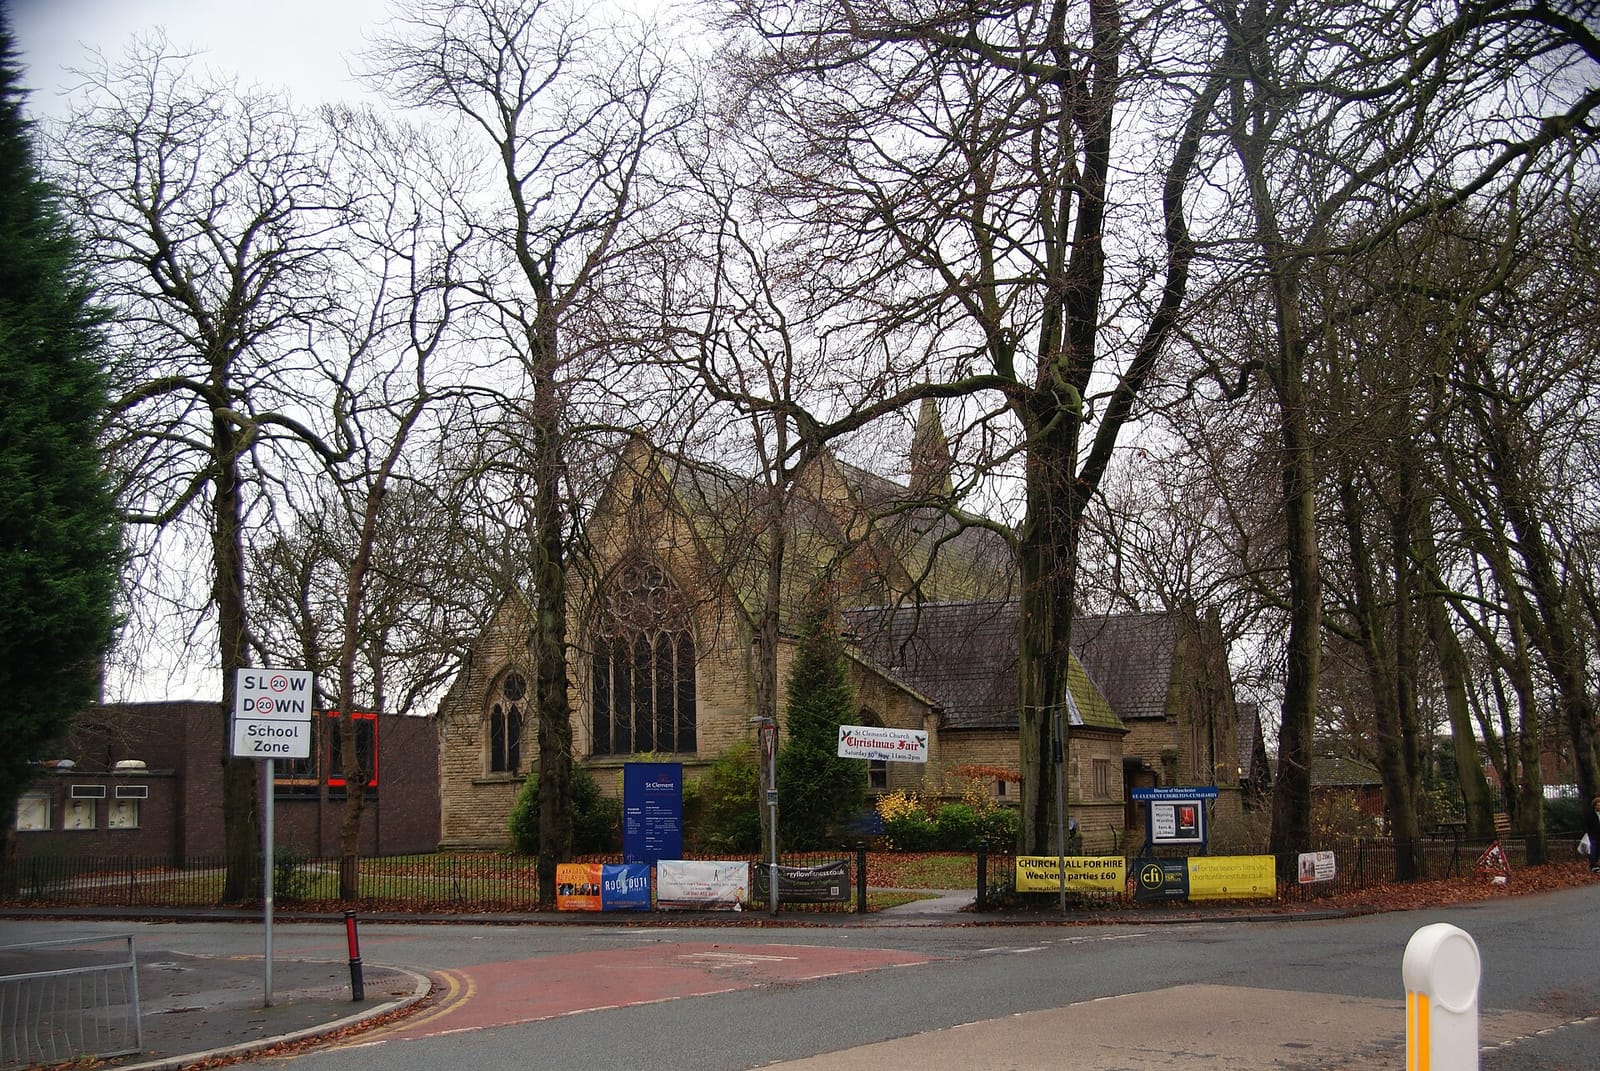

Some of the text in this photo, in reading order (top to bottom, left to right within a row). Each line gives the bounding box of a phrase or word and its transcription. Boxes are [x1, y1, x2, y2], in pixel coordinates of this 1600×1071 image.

[247, 725, 299, 738] School
[862, 730, 888, 738] Clement's
[889, 732, 910, 740] Church
[254, 740, 290, 753] Zone
[846, 736, 920, 751] Christmas Fair
[845, 749, 867, 757] Saturday
[1018, 859, 1056, 868] CHURCH
[1083, 860, 1101, 868] FOR
[1103, 859, 1123, 868] HIRE
[1068, 872, 1098, 881] parties
[1100, 872, 1117, 880] £60
[628, 877, 647, 889] OUT!
